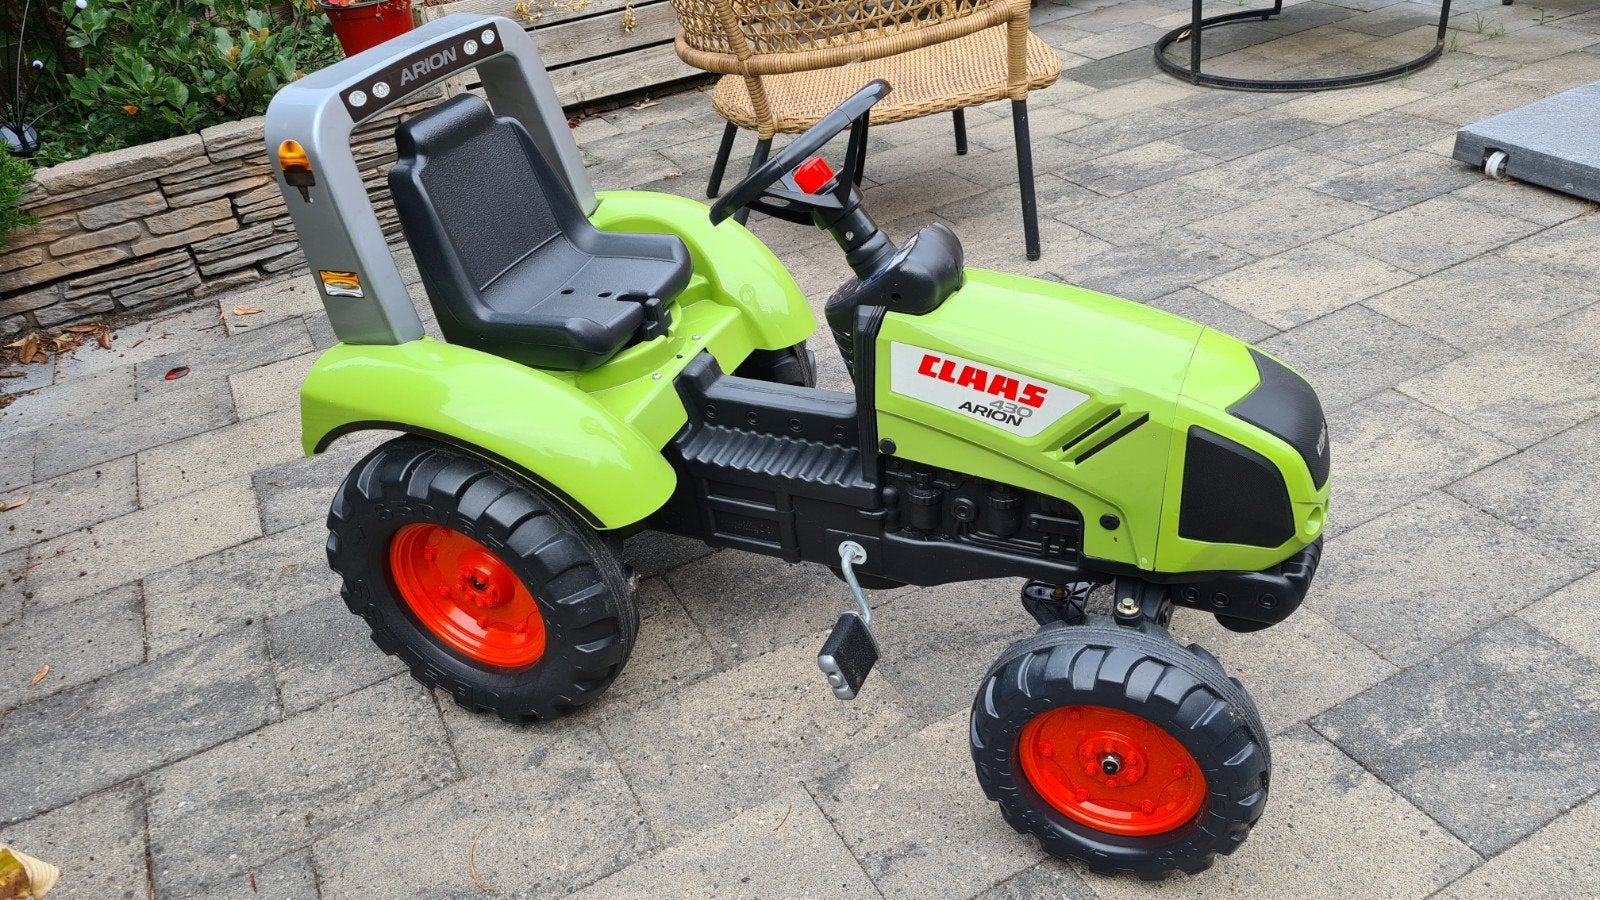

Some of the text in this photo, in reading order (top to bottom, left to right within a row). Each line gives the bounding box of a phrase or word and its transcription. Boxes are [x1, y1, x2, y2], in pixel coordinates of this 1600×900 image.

[400, 45, 457, 87] ARION
[917, 353, 1048, 409] CLAAS
[958, 401, 1023, 427] ARION
[988, 399, 1033, 419] 430
